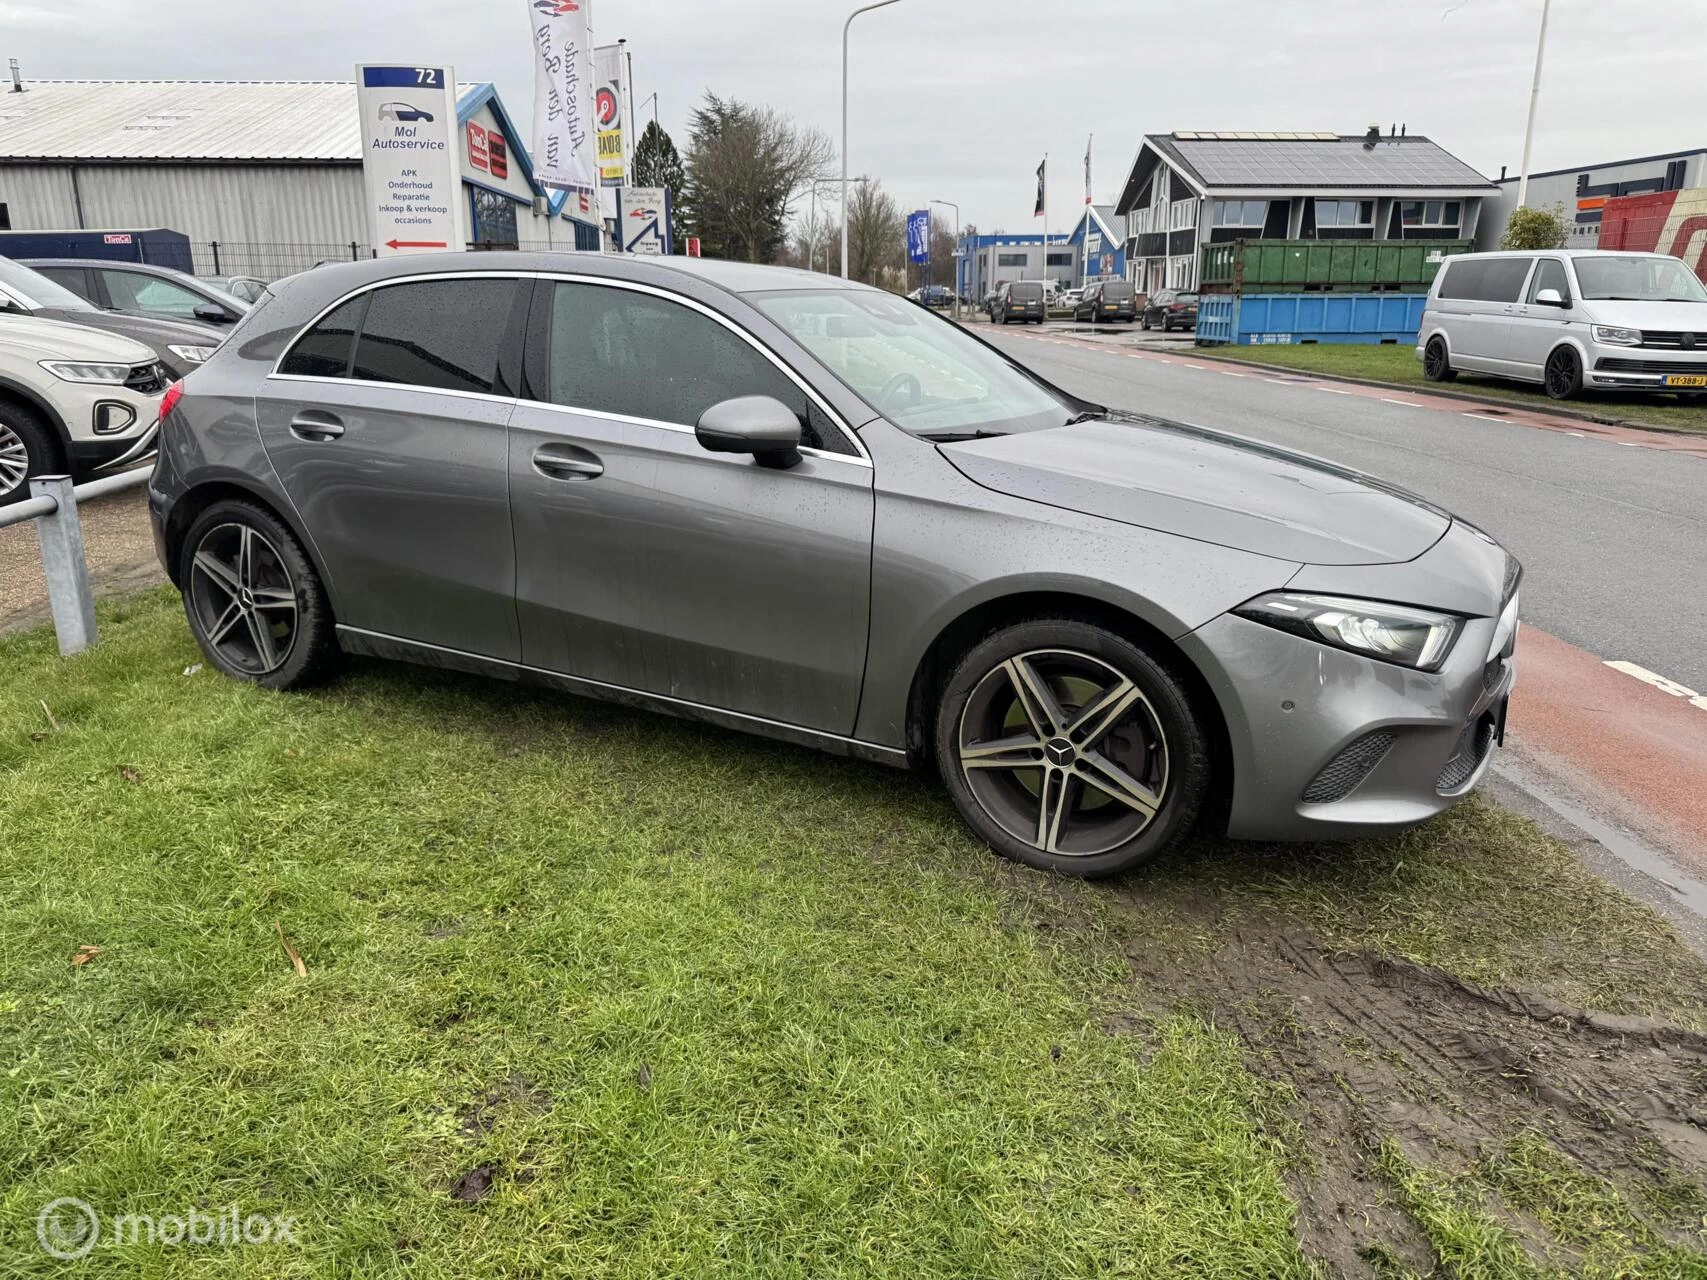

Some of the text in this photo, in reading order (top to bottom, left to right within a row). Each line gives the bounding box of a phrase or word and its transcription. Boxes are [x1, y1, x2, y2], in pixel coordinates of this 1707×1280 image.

[415, 68, 436, 84] 72
[394, 126, 417, 138] Mol
[372, 138, 445, 150] Autoservice
[401, 169, 417, 177] APK
[388, 181, 433, 189] Onderhoud
[392, 193, 430, 201] Reparatie
[378, 205, 405, 213] Inkoop
[414, 205, 448, 214] verkoop
[394, 216, 432, 225] occasions
